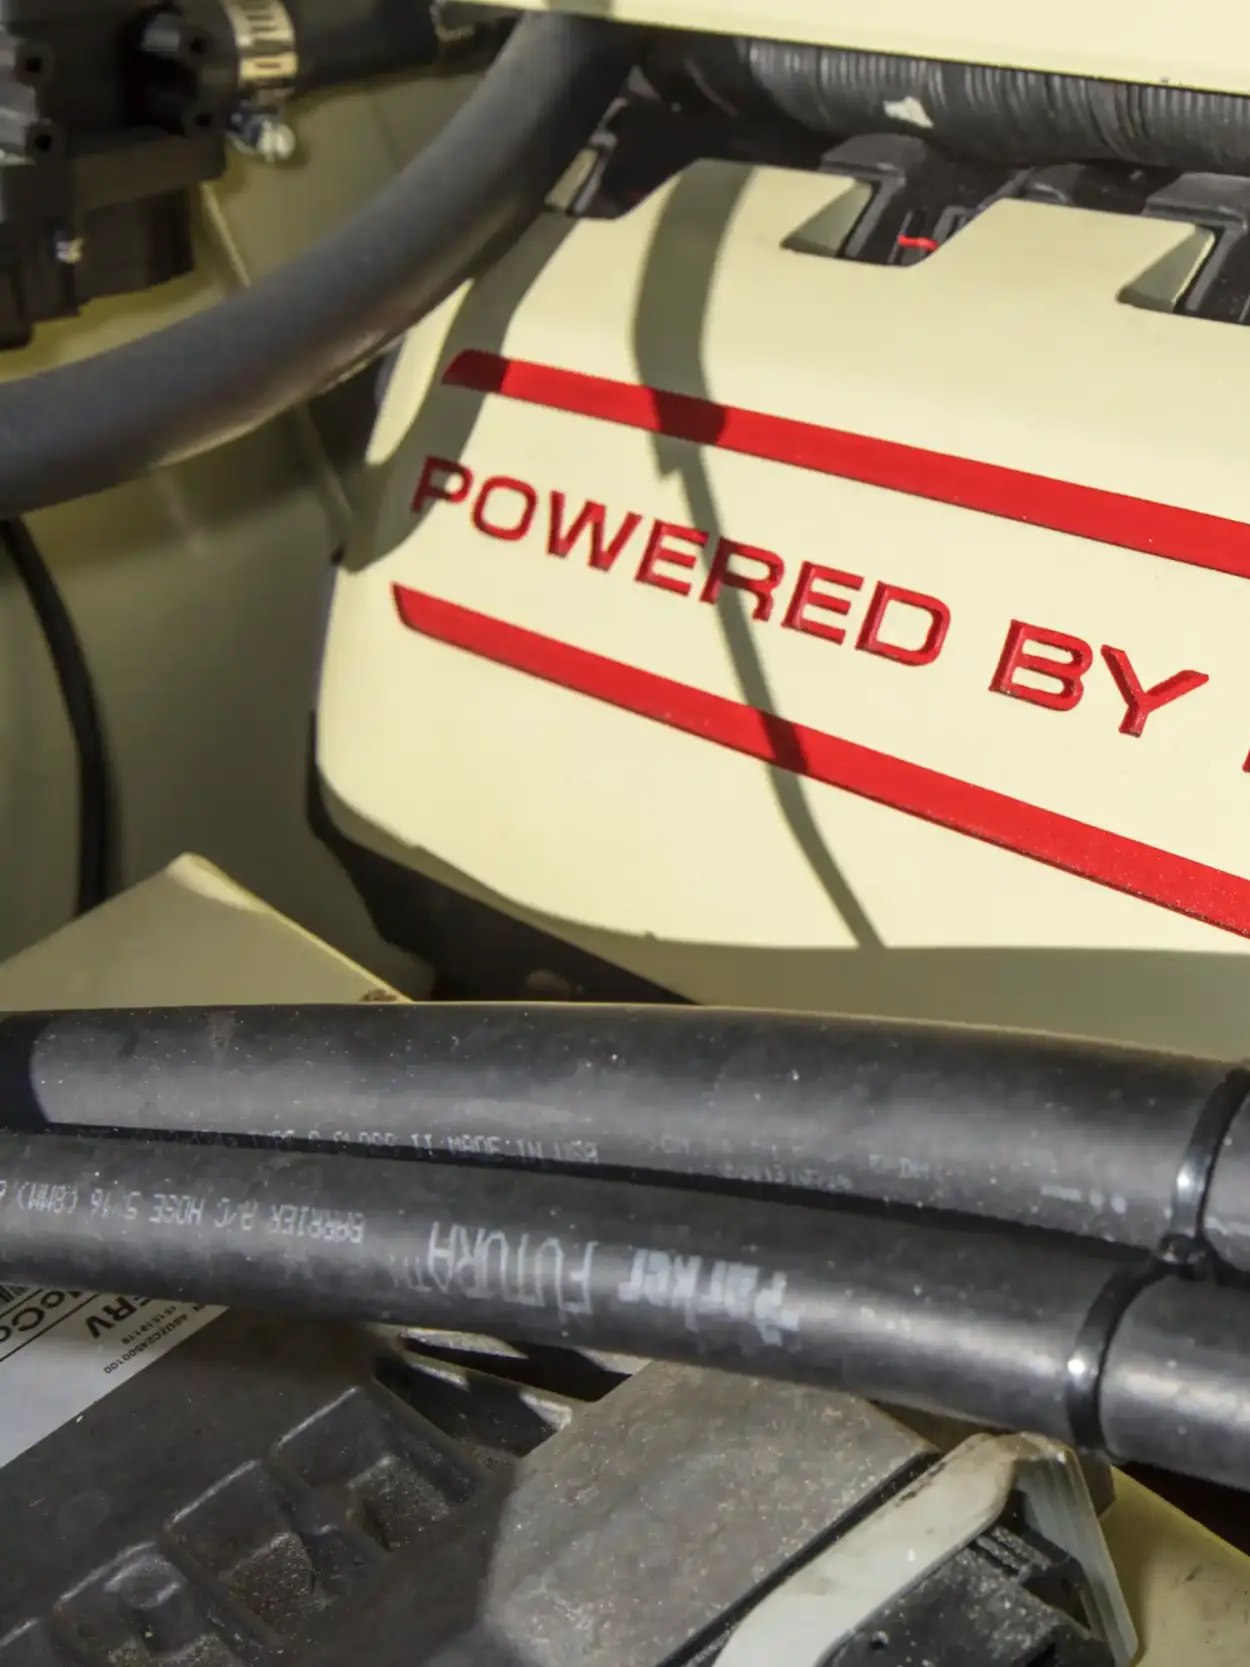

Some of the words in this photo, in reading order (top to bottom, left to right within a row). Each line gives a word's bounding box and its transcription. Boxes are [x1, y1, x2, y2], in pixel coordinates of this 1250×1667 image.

[412, 456, 951, 667] POWERED
[988, 619, 1209, 738] BY
[149, 1193, 204, 1226] HOSE
[269, 1201, 366, 1244] BARRIER
